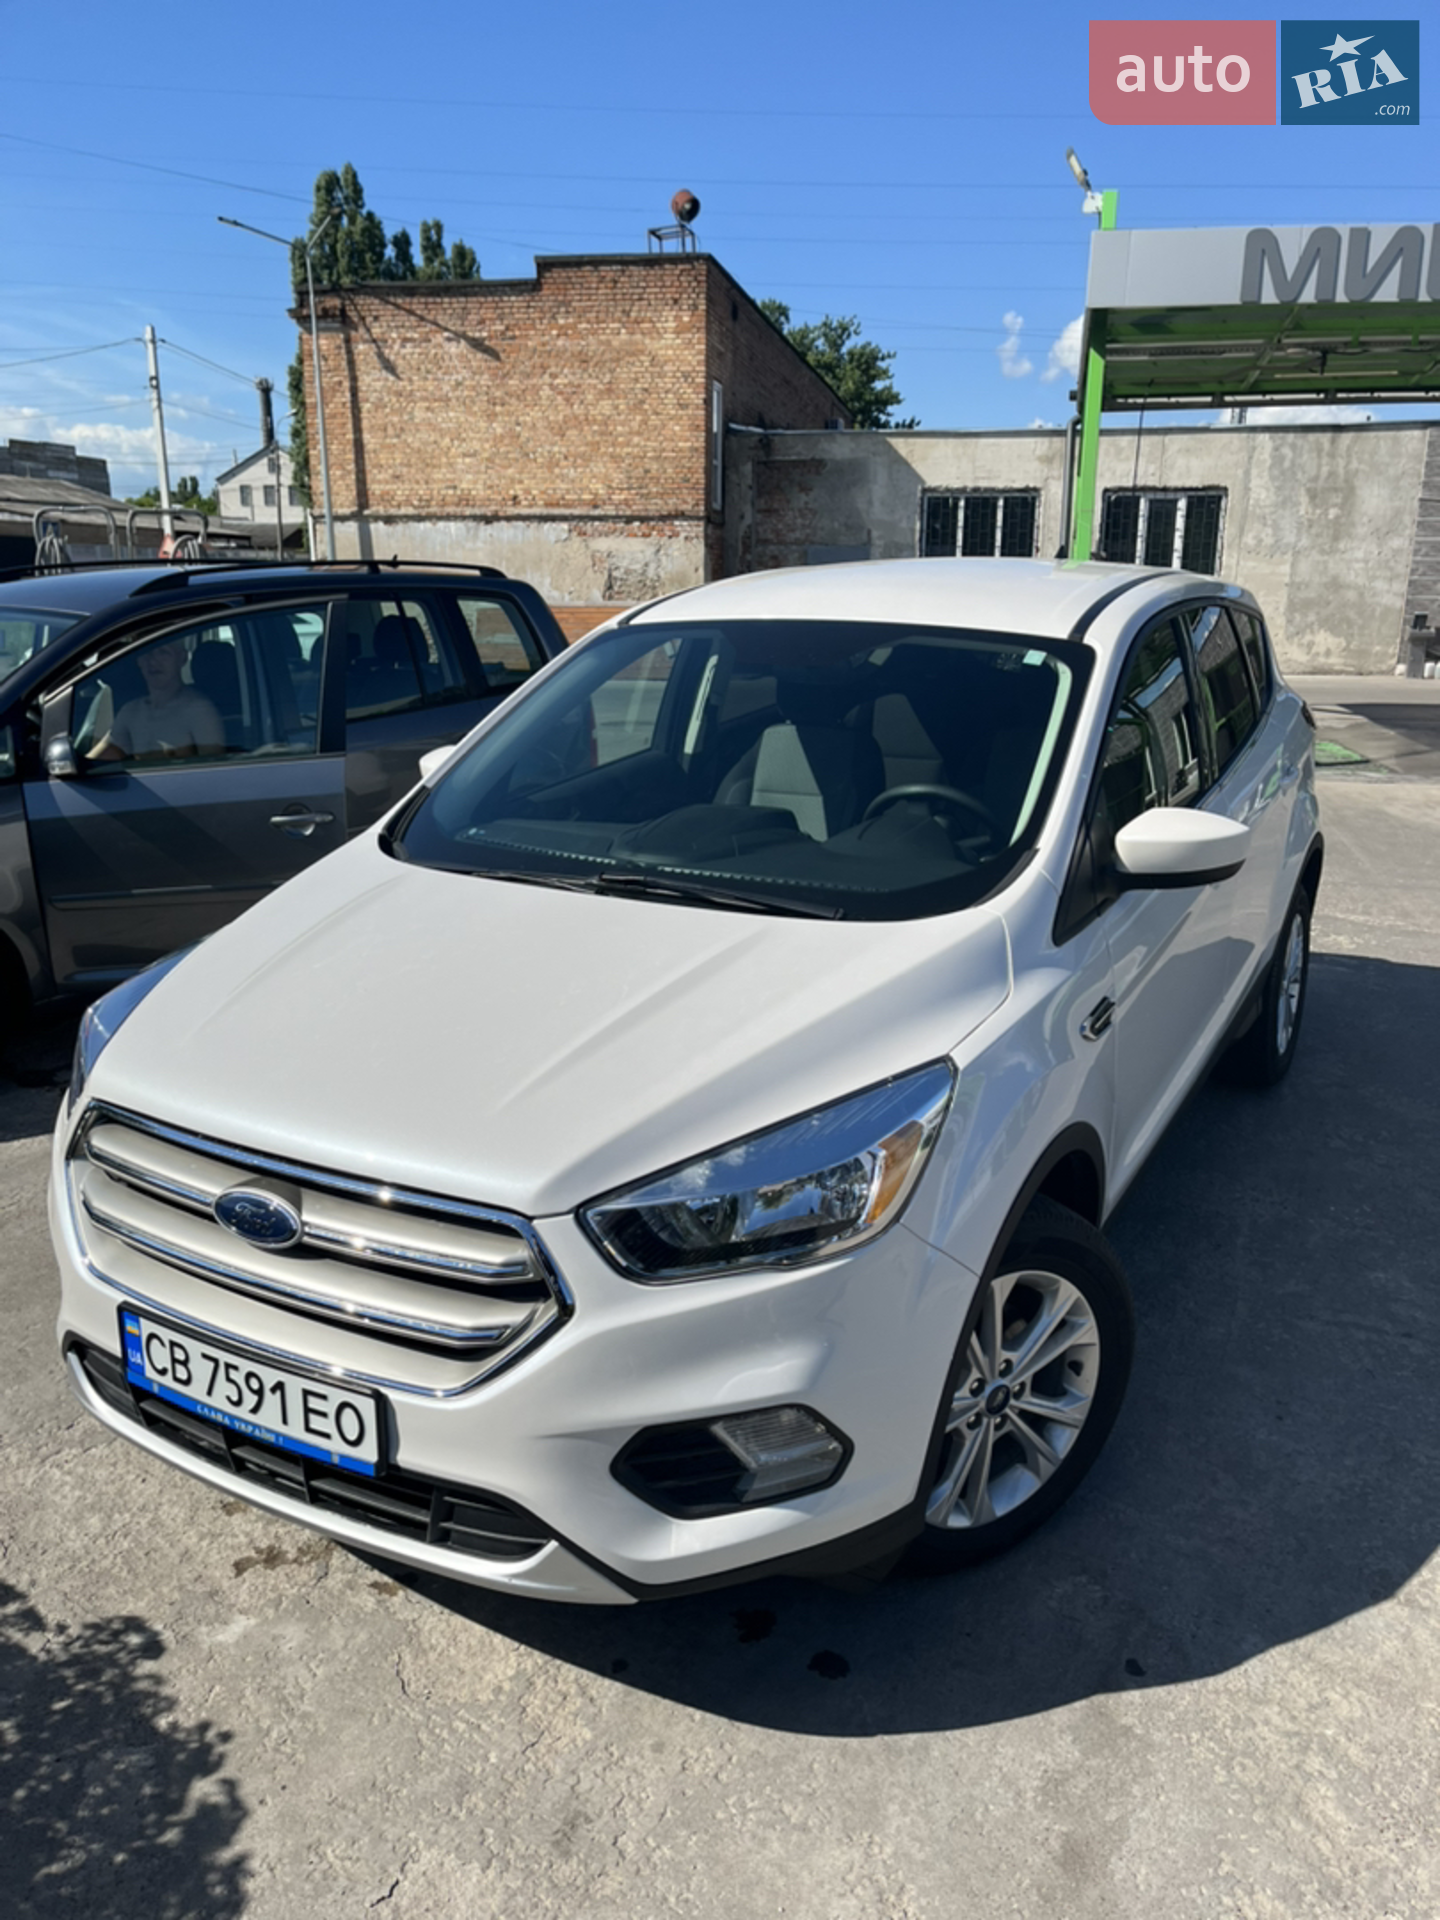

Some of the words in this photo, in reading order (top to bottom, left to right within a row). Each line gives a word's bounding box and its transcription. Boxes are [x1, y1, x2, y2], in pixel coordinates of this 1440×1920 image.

[1240, 224, 1440, 304] МИ
[127, 1347, 143, 1366] UA
[145, 1332, 193, 1387] CB
[201, 1352, 288, 1426] 7591
[302, 1388, 365, 1448] EO
